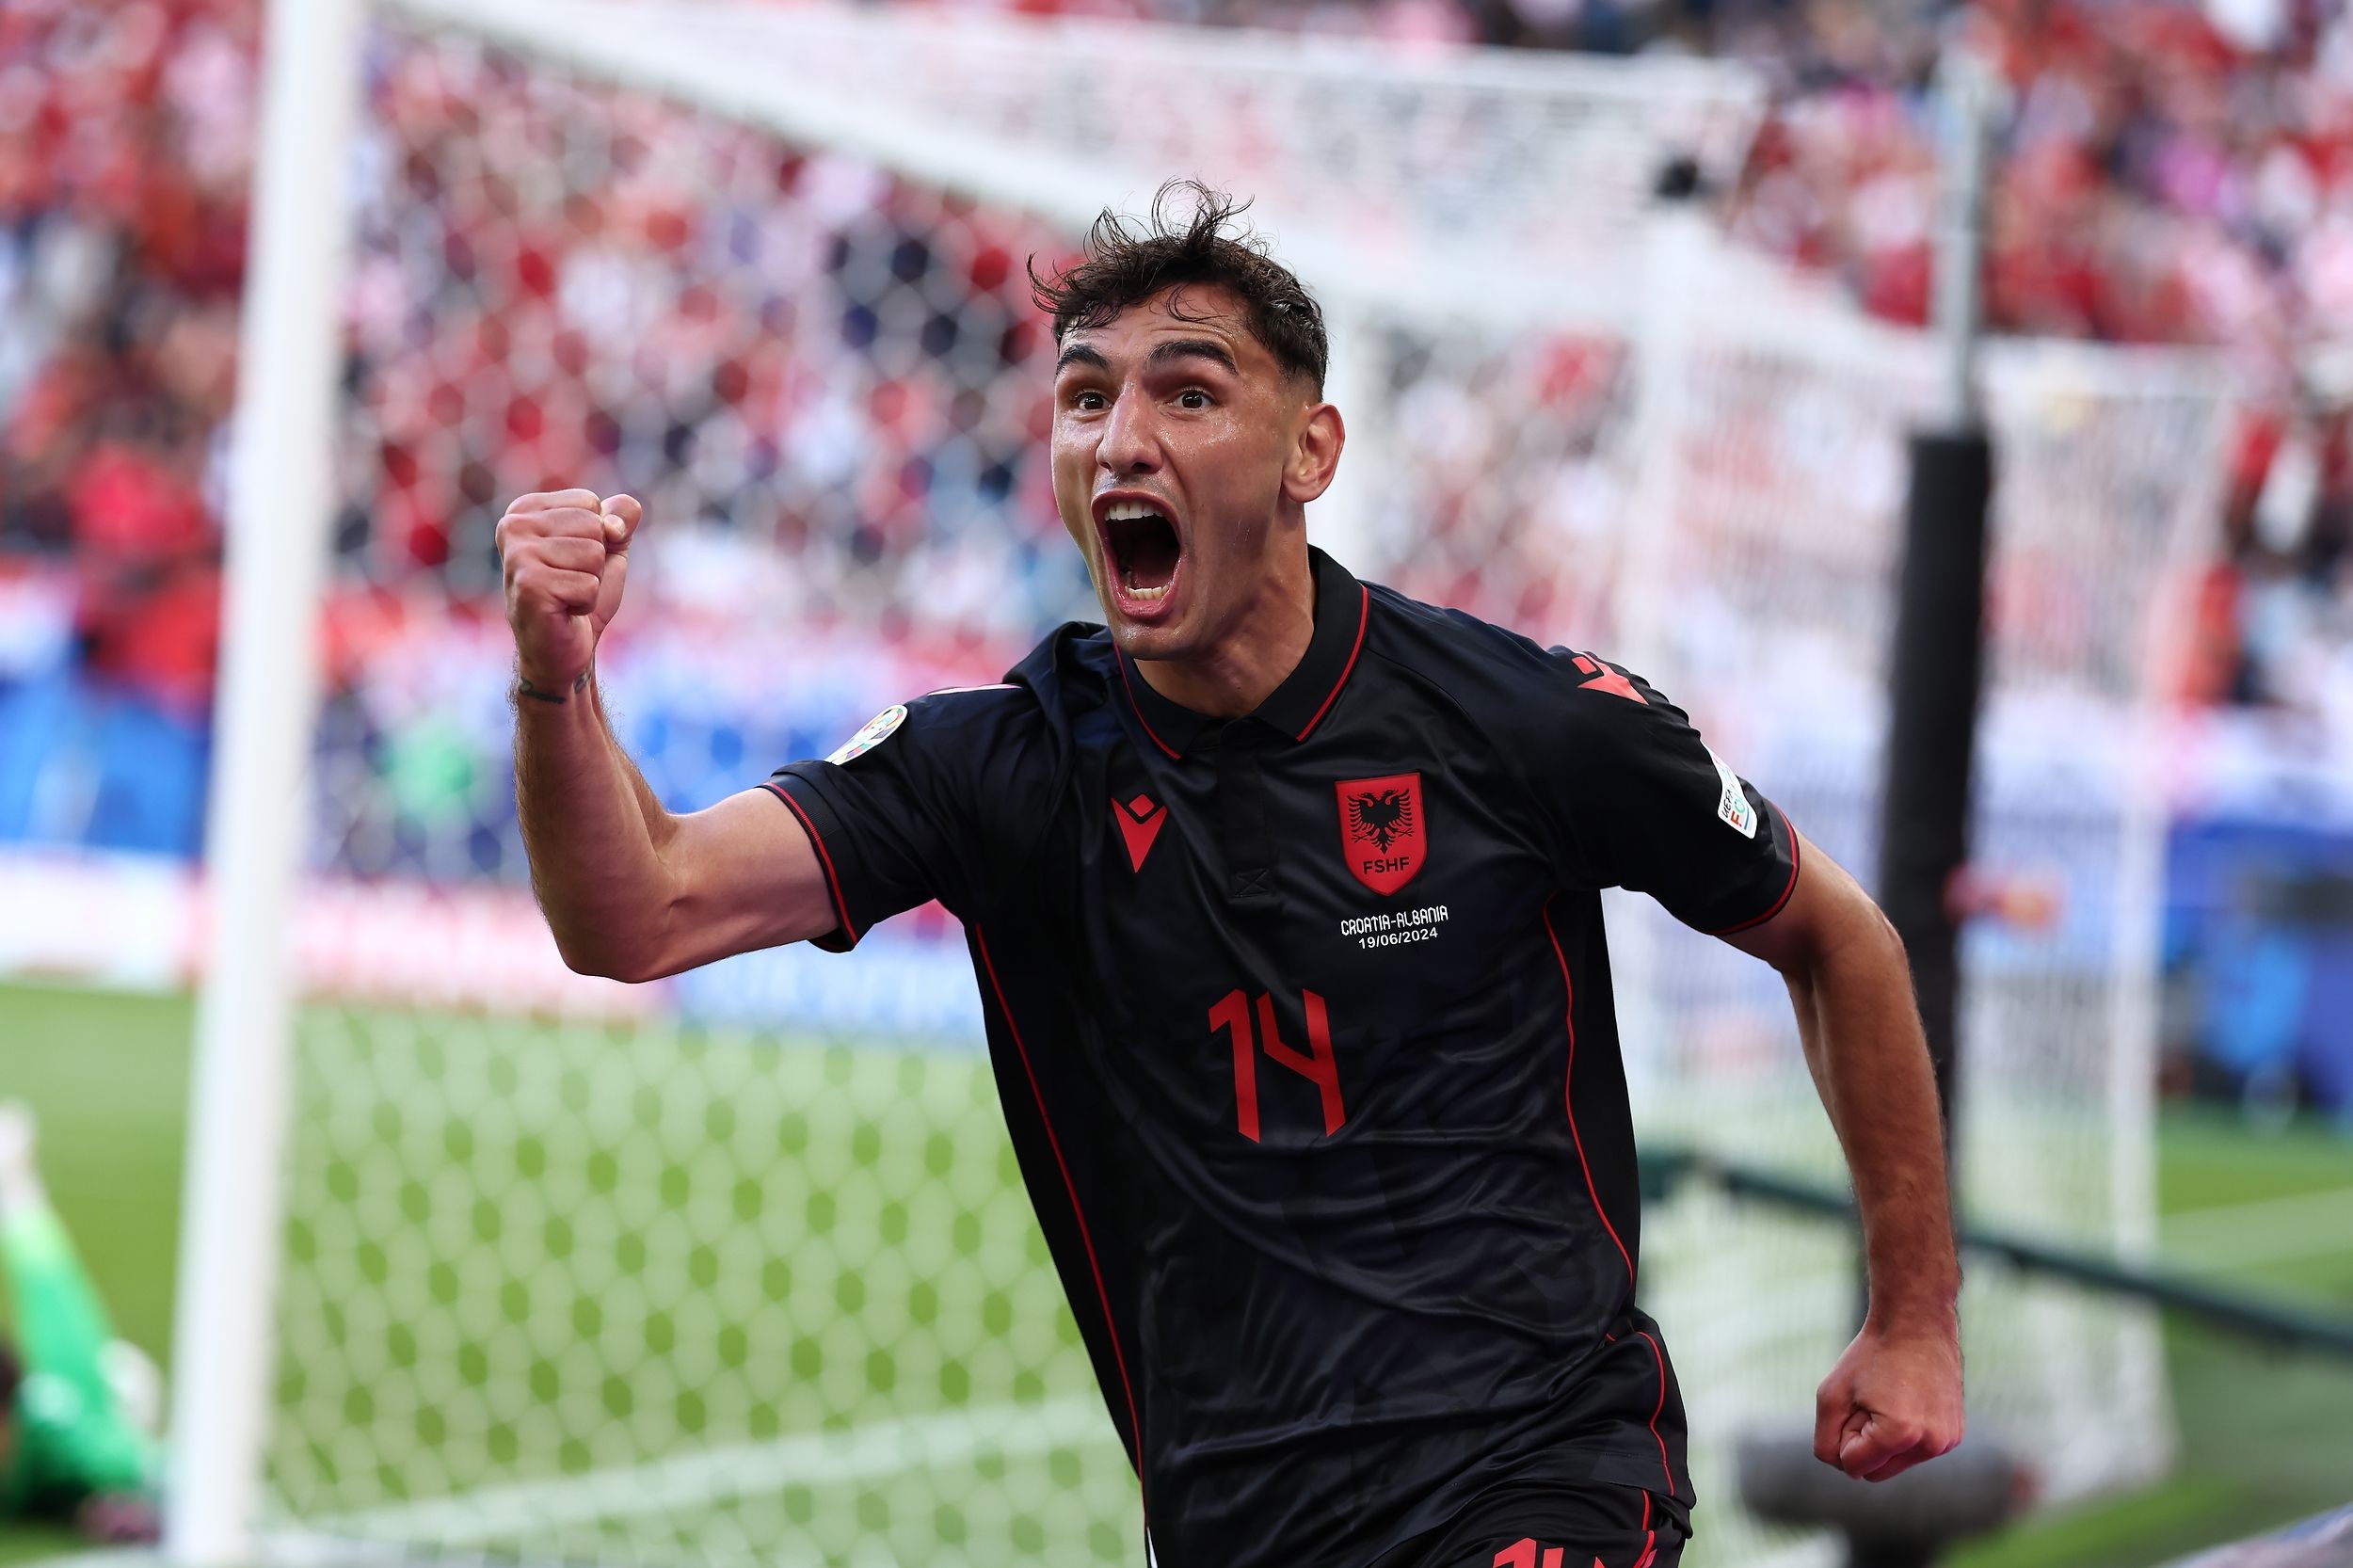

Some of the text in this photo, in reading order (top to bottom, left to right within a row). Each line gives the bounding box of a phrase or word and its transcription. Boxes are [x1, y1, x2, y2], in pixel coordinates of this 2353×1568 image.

[1363, 856, 1410, 874] FSHF
[1340, 904, 1449, 936] CROATIA-ALBANIA
[1358, 927, 1438, 949] 19/06/2024
[1209, 988, 1346, 1144] 14
